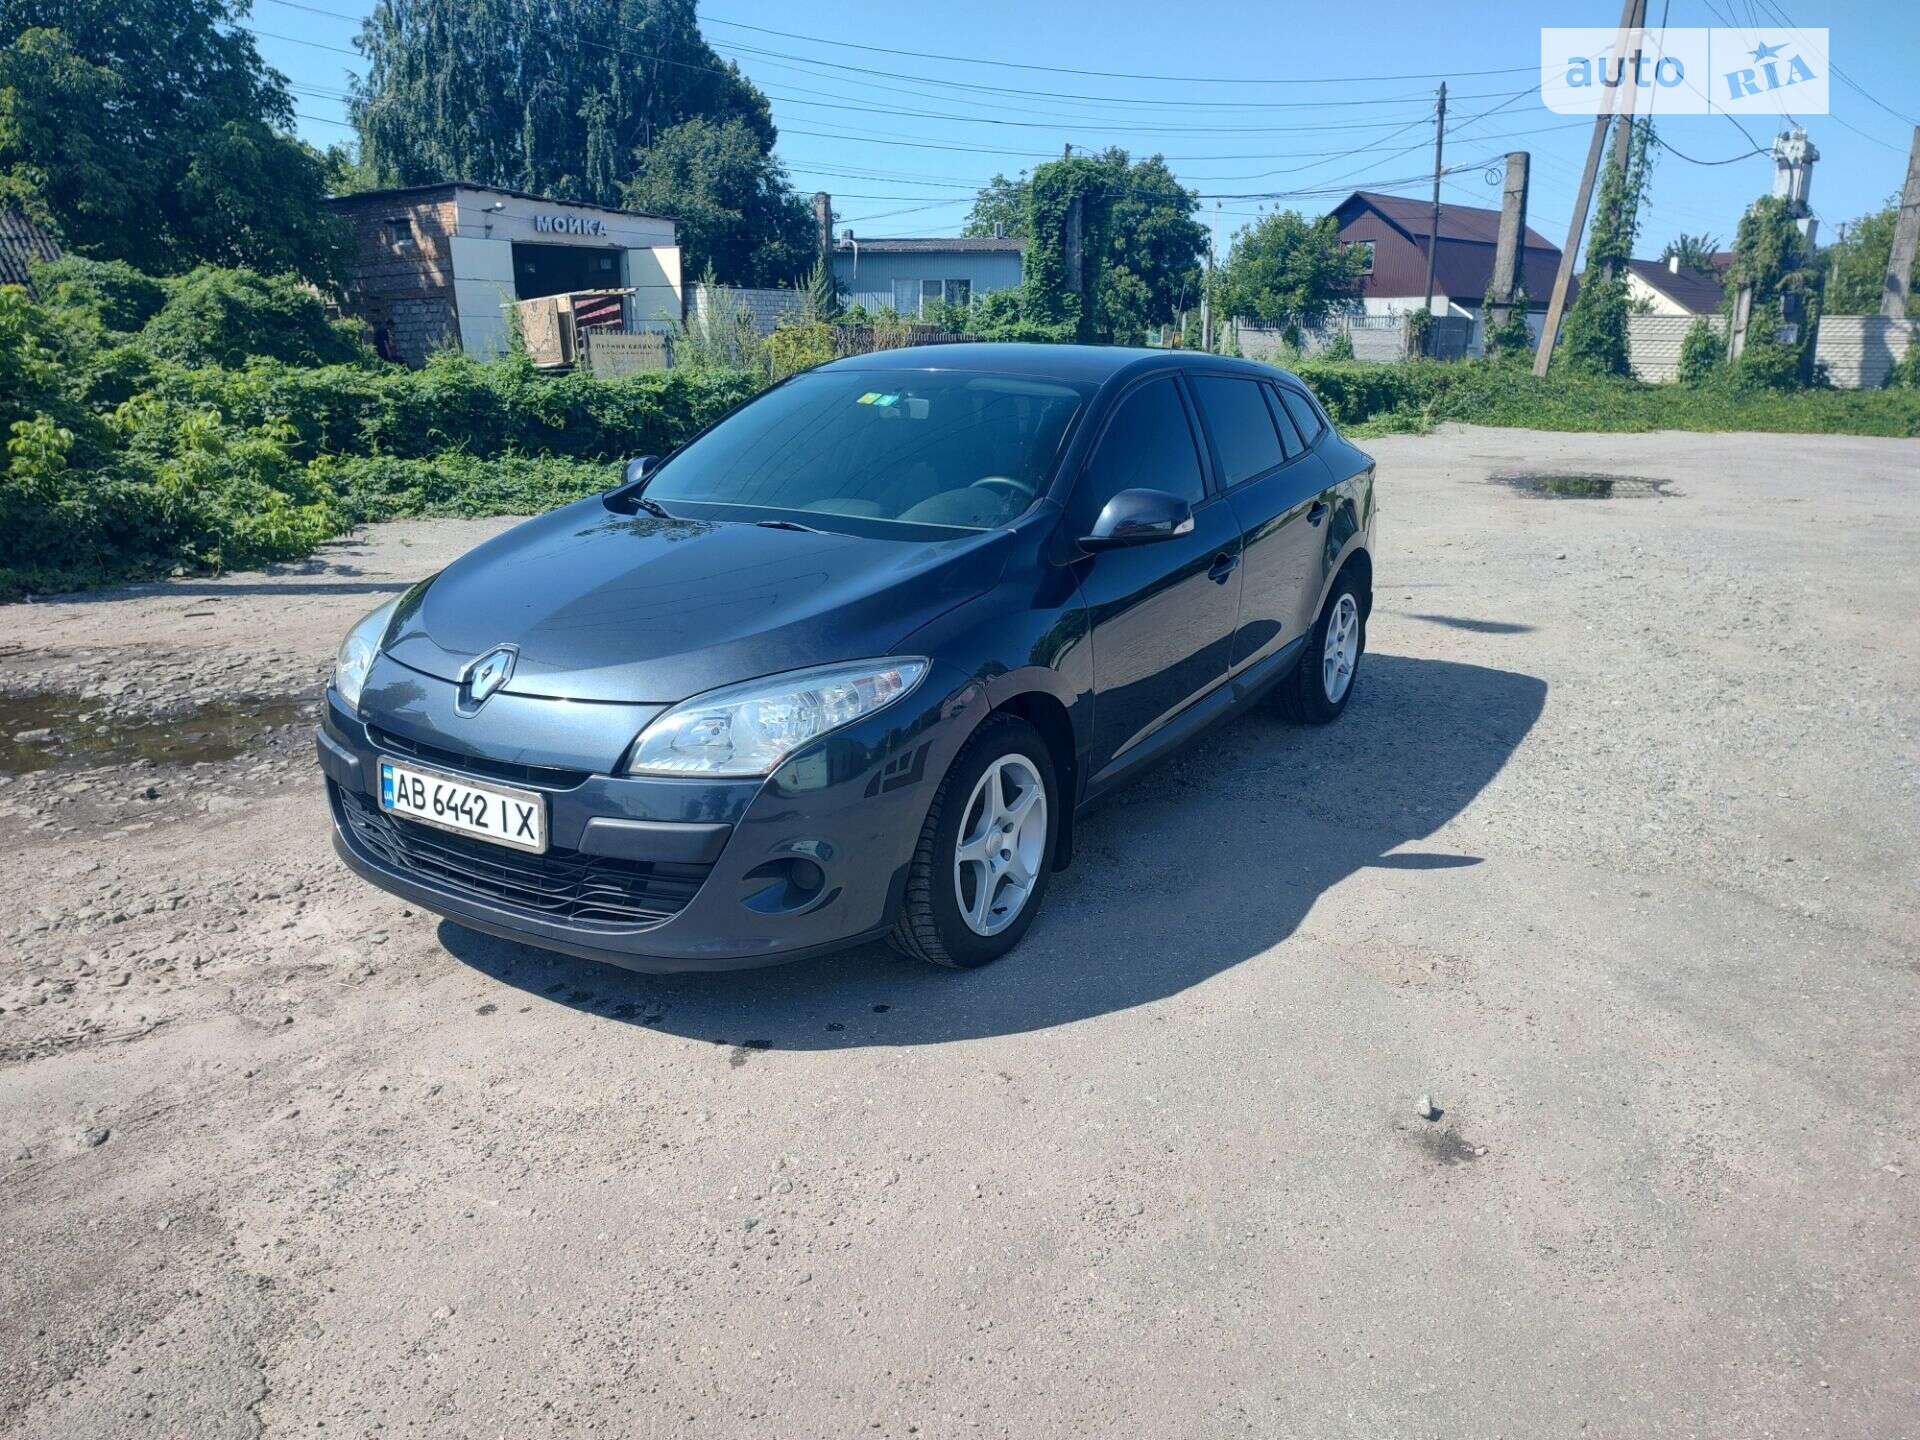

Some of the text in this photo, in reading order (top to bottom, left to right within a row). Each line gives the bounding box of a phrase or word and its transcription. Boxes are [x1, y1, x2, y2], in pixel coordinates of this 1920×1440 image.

[535, 213, 608, 238] МОЙКА
[397, 774, 535, 840] AB 6442 IX
